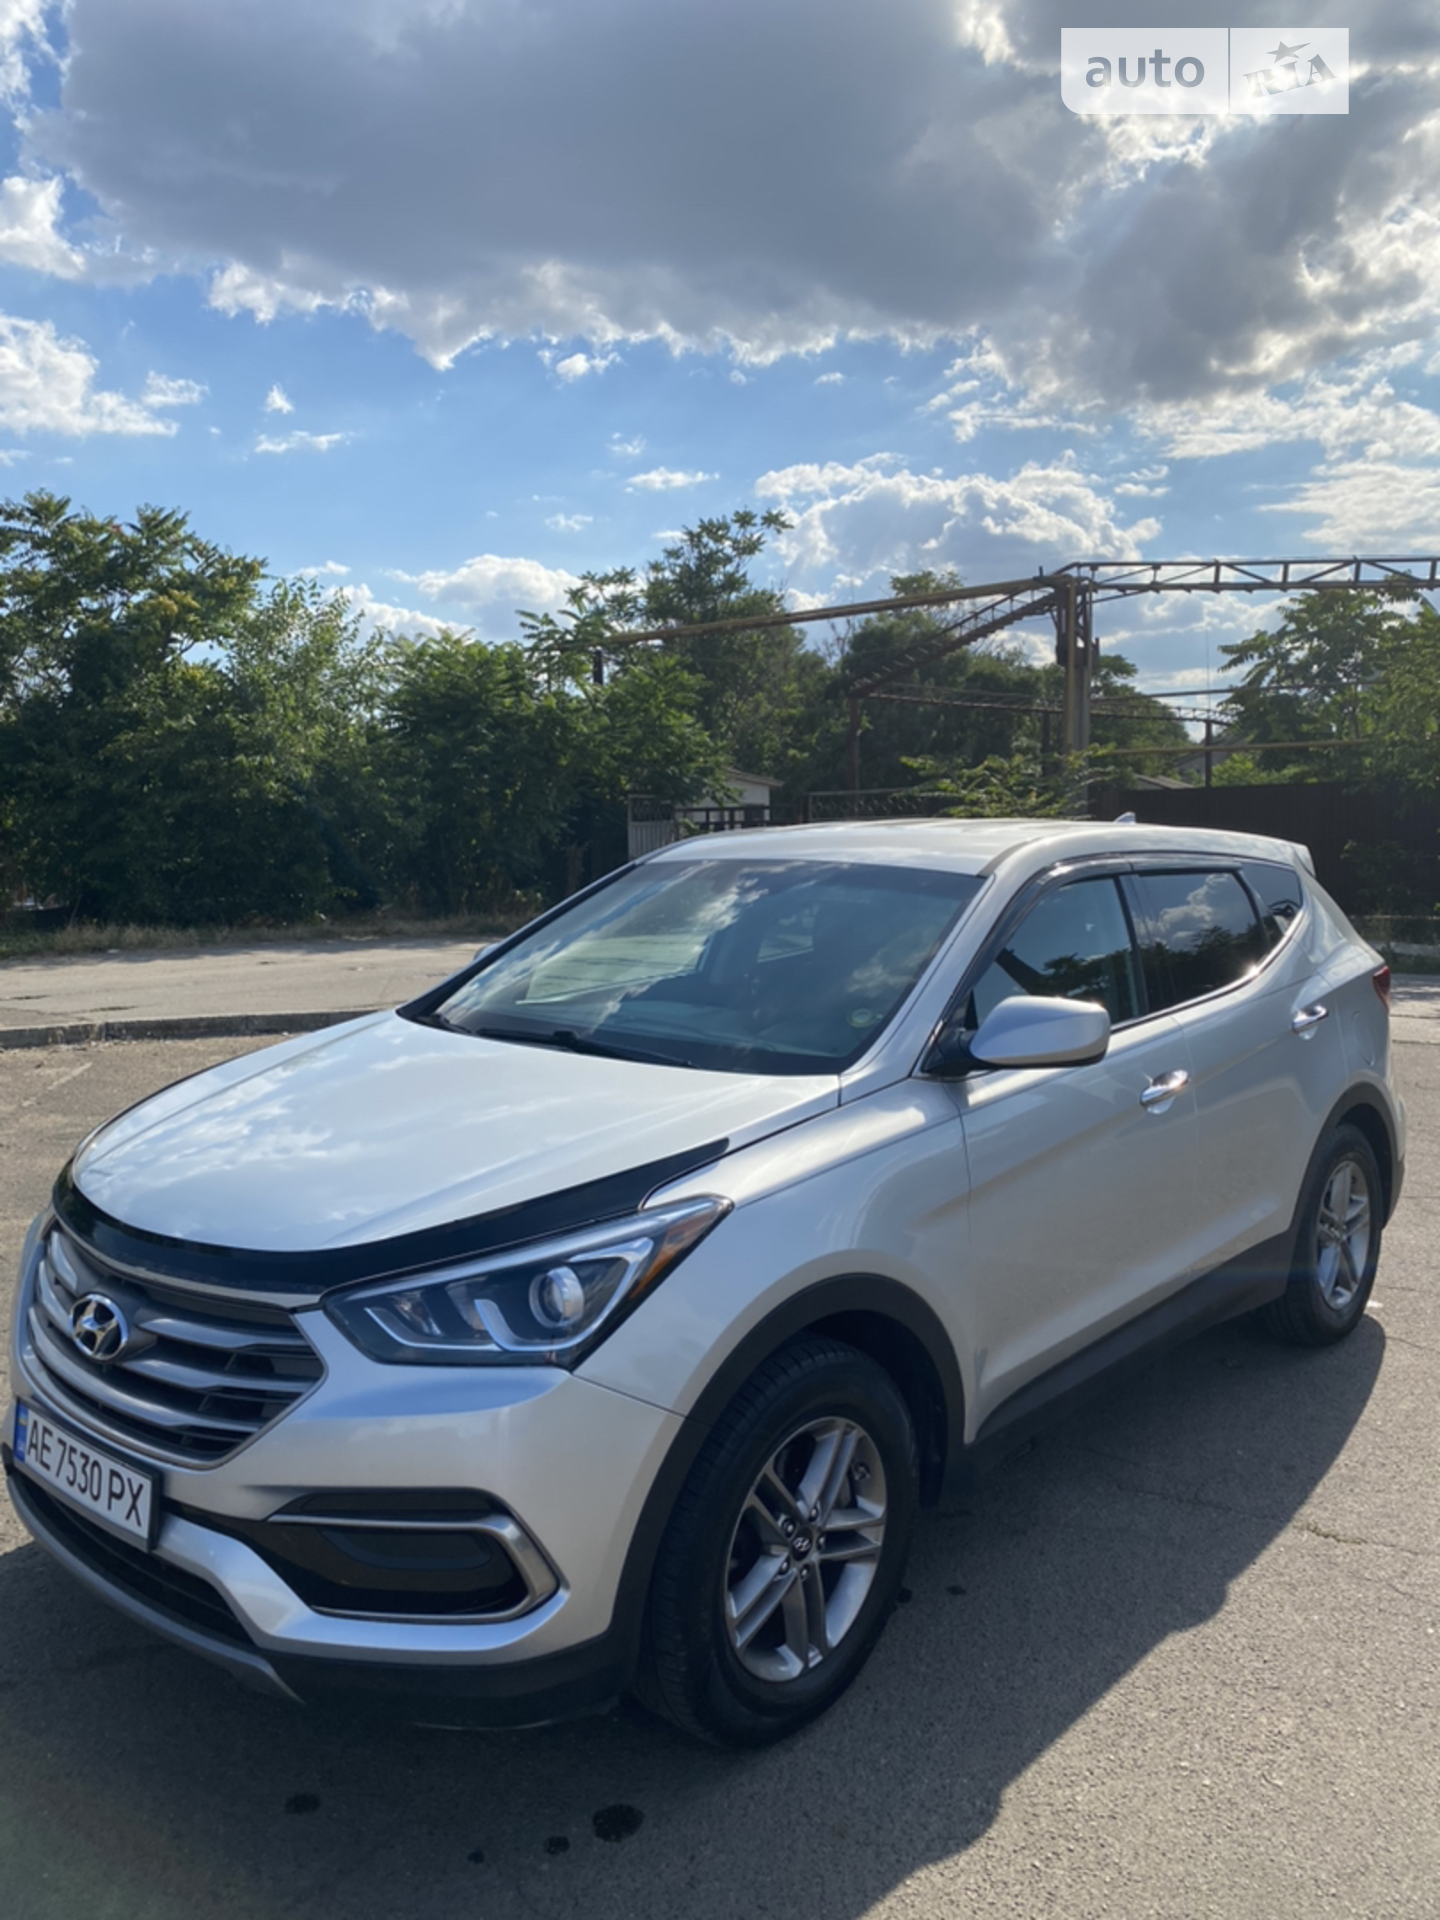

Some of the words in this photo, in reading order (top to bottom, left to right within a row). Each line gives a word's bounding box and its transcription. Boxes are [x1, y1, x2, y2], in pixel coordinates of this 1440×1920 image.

[27, 1419, 54, 1472] AE
[56, 1437, 102, 1502] 7530
[107, 1468, 144, 1528] PX
